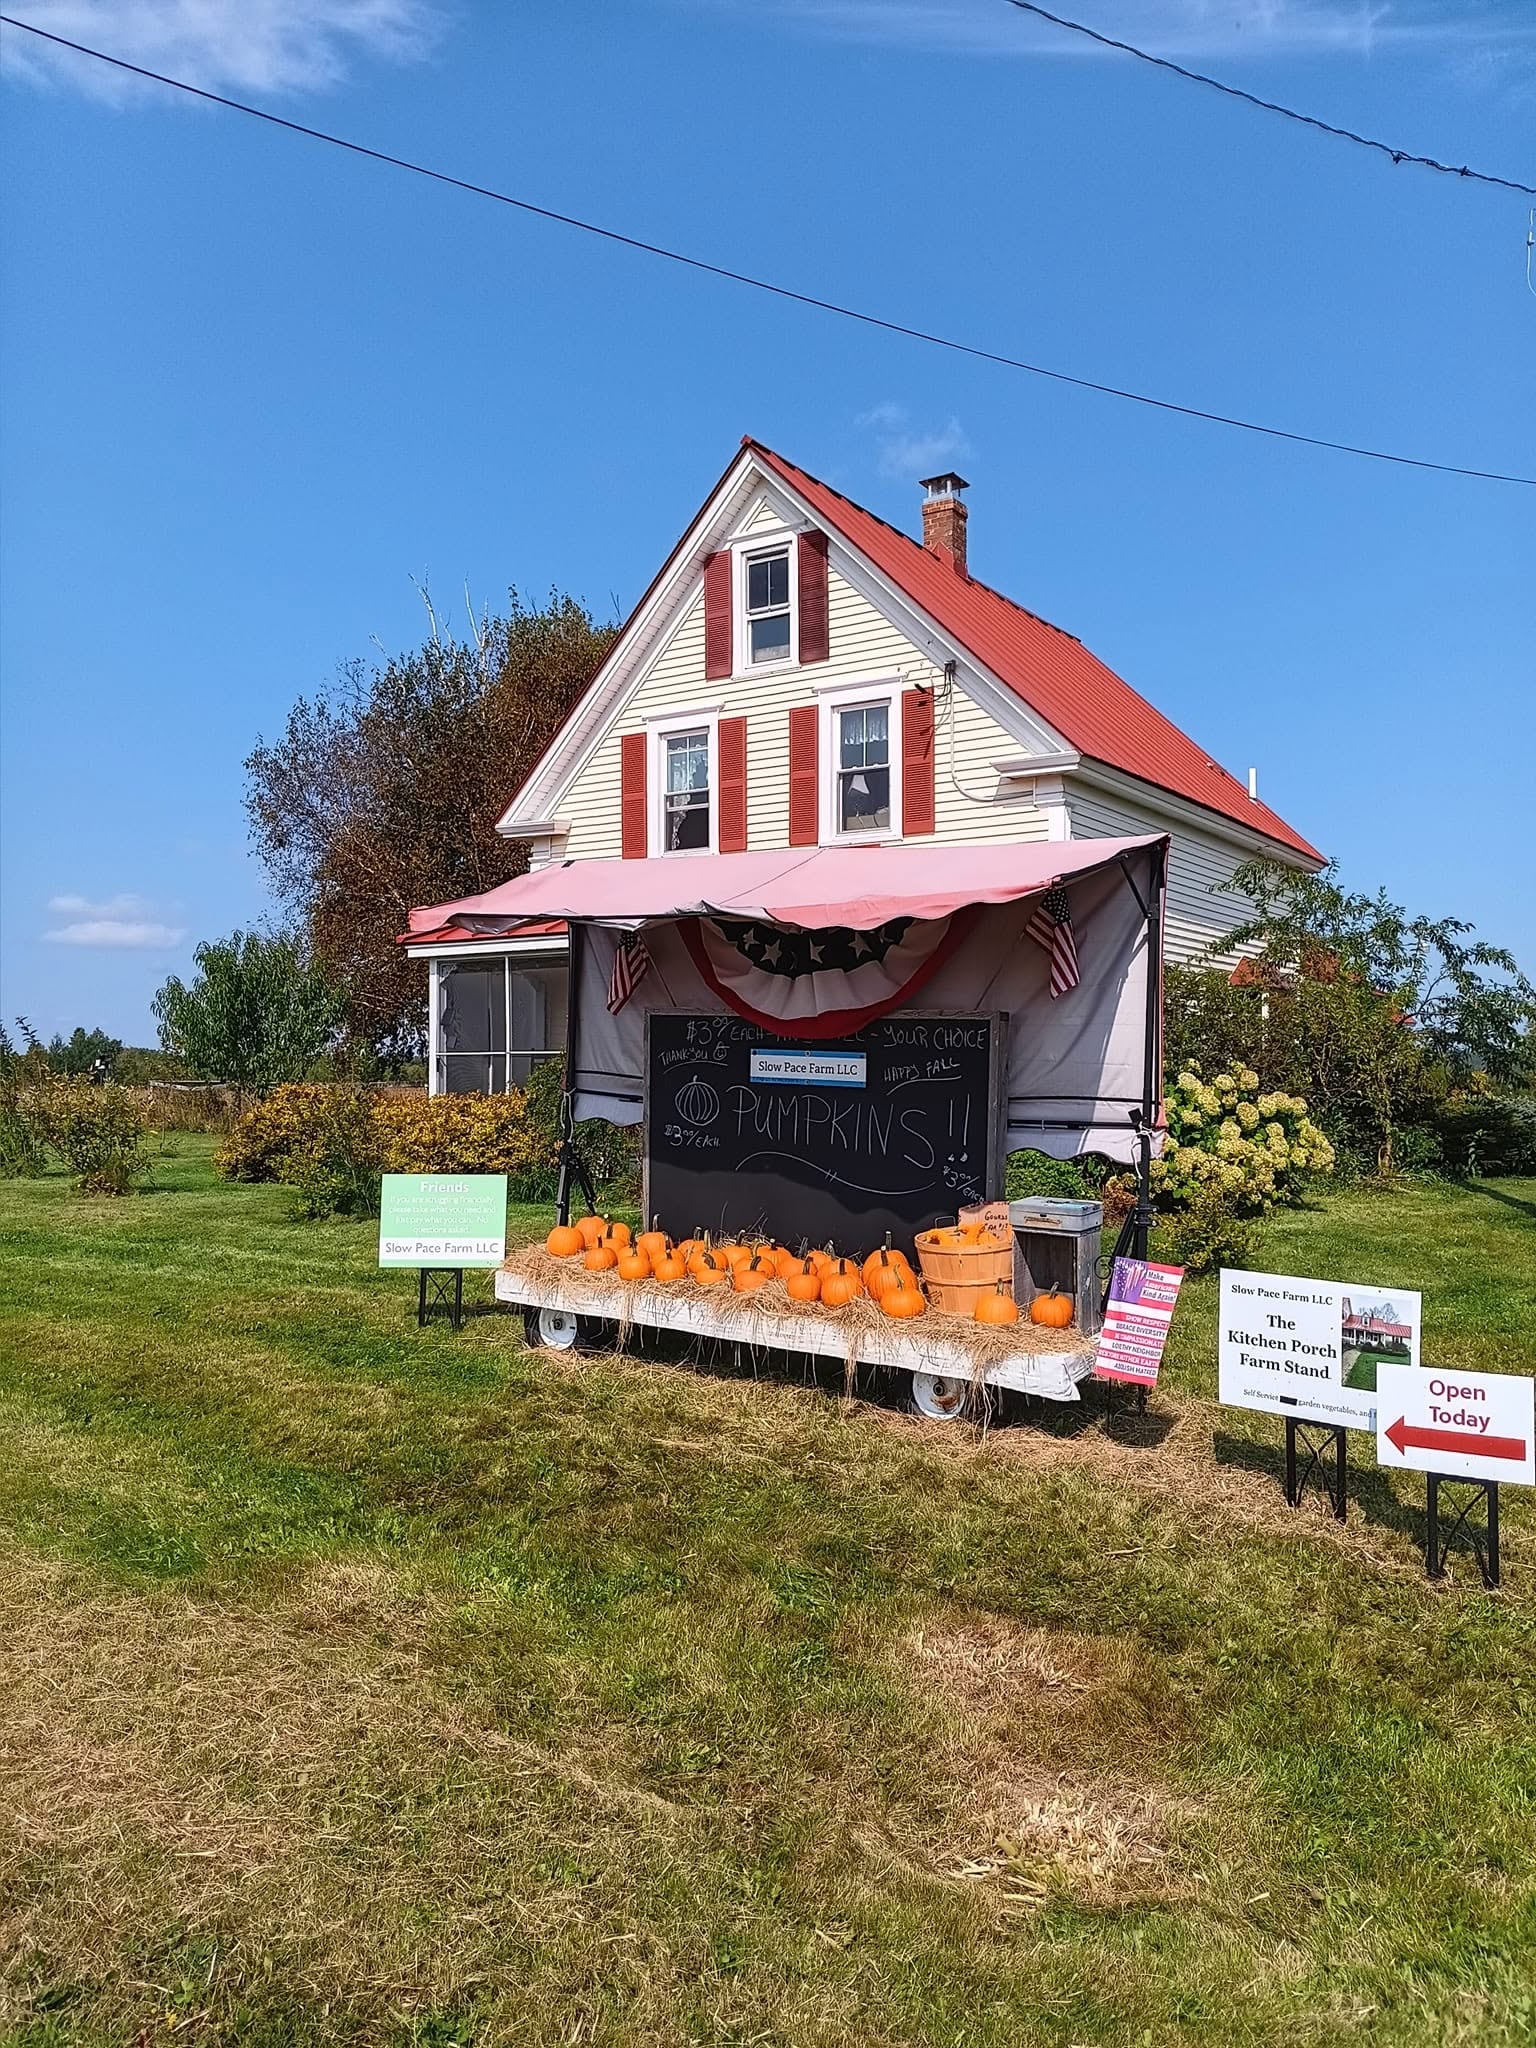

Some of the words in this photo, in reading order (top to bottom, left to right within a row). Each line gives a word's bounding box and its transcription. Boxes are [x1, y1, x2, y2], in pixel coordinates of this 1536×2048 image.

[883, 1025, 928, 1048] YOUR
[933, 1027, 987, 1049] CHOICE
[758, 1060, 782, 1072] Slow
[784, 1062, 807, 1073] Pace
[809, 1063, 835, 1075] Farm
[837, 1064, 858, 1076] LLC
[883, 1063, 920, 1080] HAPPY
[926, 1057, 960, 1078] FALL
[420, 1181, 469, 1193] Friends
[385, 1242, 412, 1253] Slow
[415, 1242, 441, 1253] Pace
[444, 1242, 473, 1253] Farm
[476, 1242, 499, 1253] LLC
[1142, 1289, 1157, 1299] Kind
[1231, 1284, 1256, 1296] Slow
[1257, 1287, 1281, 1299] Pace
[1282, 1291, 1310, 1303] Farm
[1312, 1294, 1333, 1306] LLC
[1266, 1314, 1296, 1330] The
[1228, 1330, 1287, 1351] Kitchen
[1291, 1339, 1337, 1359] Porch
[1239, 1352, 1280, 1371] Farm
[1284, 1360, 1330, 1380] Stand
[1243, 1389, 1256, 1397] Self
[1256, 1391, 1279, 1401] Service
[1298, 1399, 1321, 1409] garden
[1429, 1379, 1486, 1402] Open
[1429, 1406, 1491, 1433] Today
